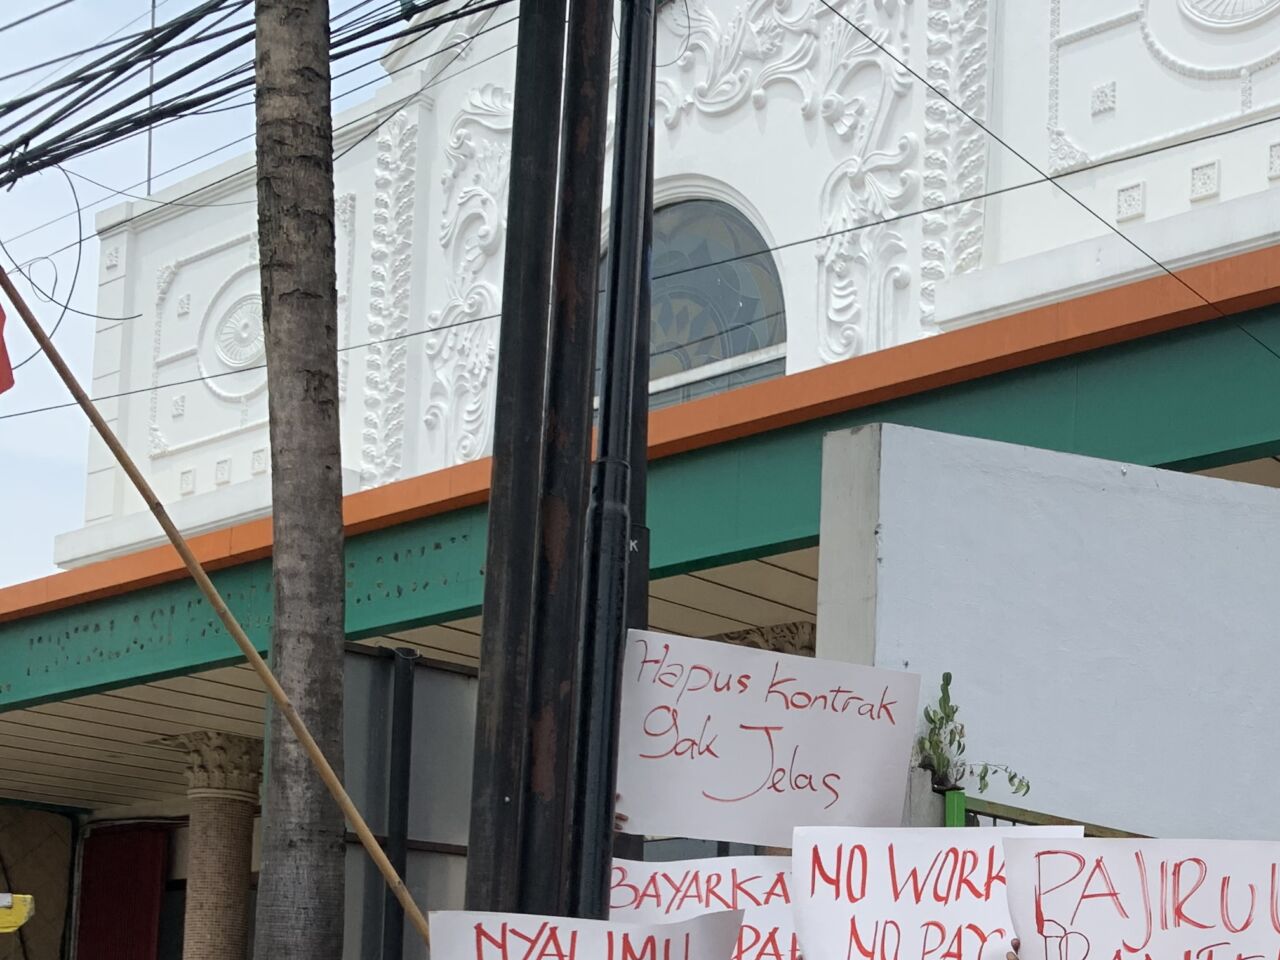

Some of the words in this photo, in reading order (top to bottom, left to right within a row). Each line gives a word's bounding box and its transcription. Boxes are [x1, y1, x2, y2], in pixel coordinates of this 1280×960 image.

[636, 640, 751, 703] Hapus
[702, 724, 841, 809] Jelas
[609, 866, 793, 914] BAYARKA
[811, 844, 867, 903] NO
[889, 843, 1006, 906] WORK
